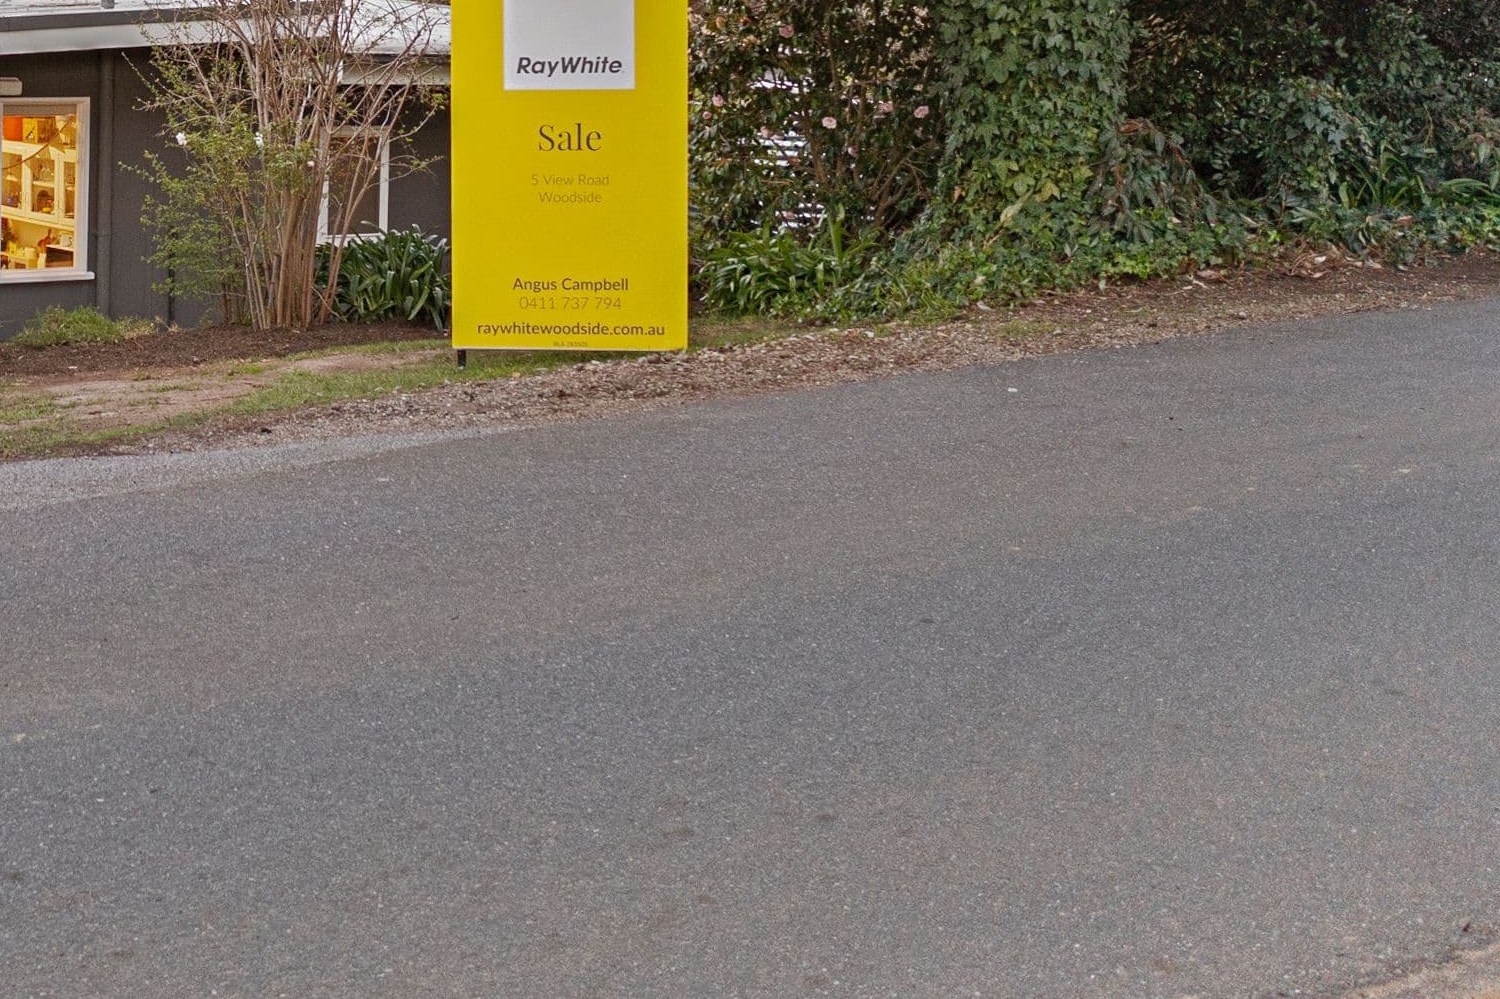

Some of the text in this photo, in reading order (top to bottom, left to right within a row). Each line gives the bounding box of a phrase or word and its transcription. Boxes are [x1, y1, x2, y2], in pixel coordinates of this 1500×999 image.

[538, 122, 603, 152] Sale
[531, 174, 610, 186] 5 View Road
[538, 191, 603, 203] Woodside
[512, 277, 629, 293] Angus Campbell
[518, 296, 622, 310] 0411 737 794
[477, 321, 666, 337] raywhitewoodside.com.au
